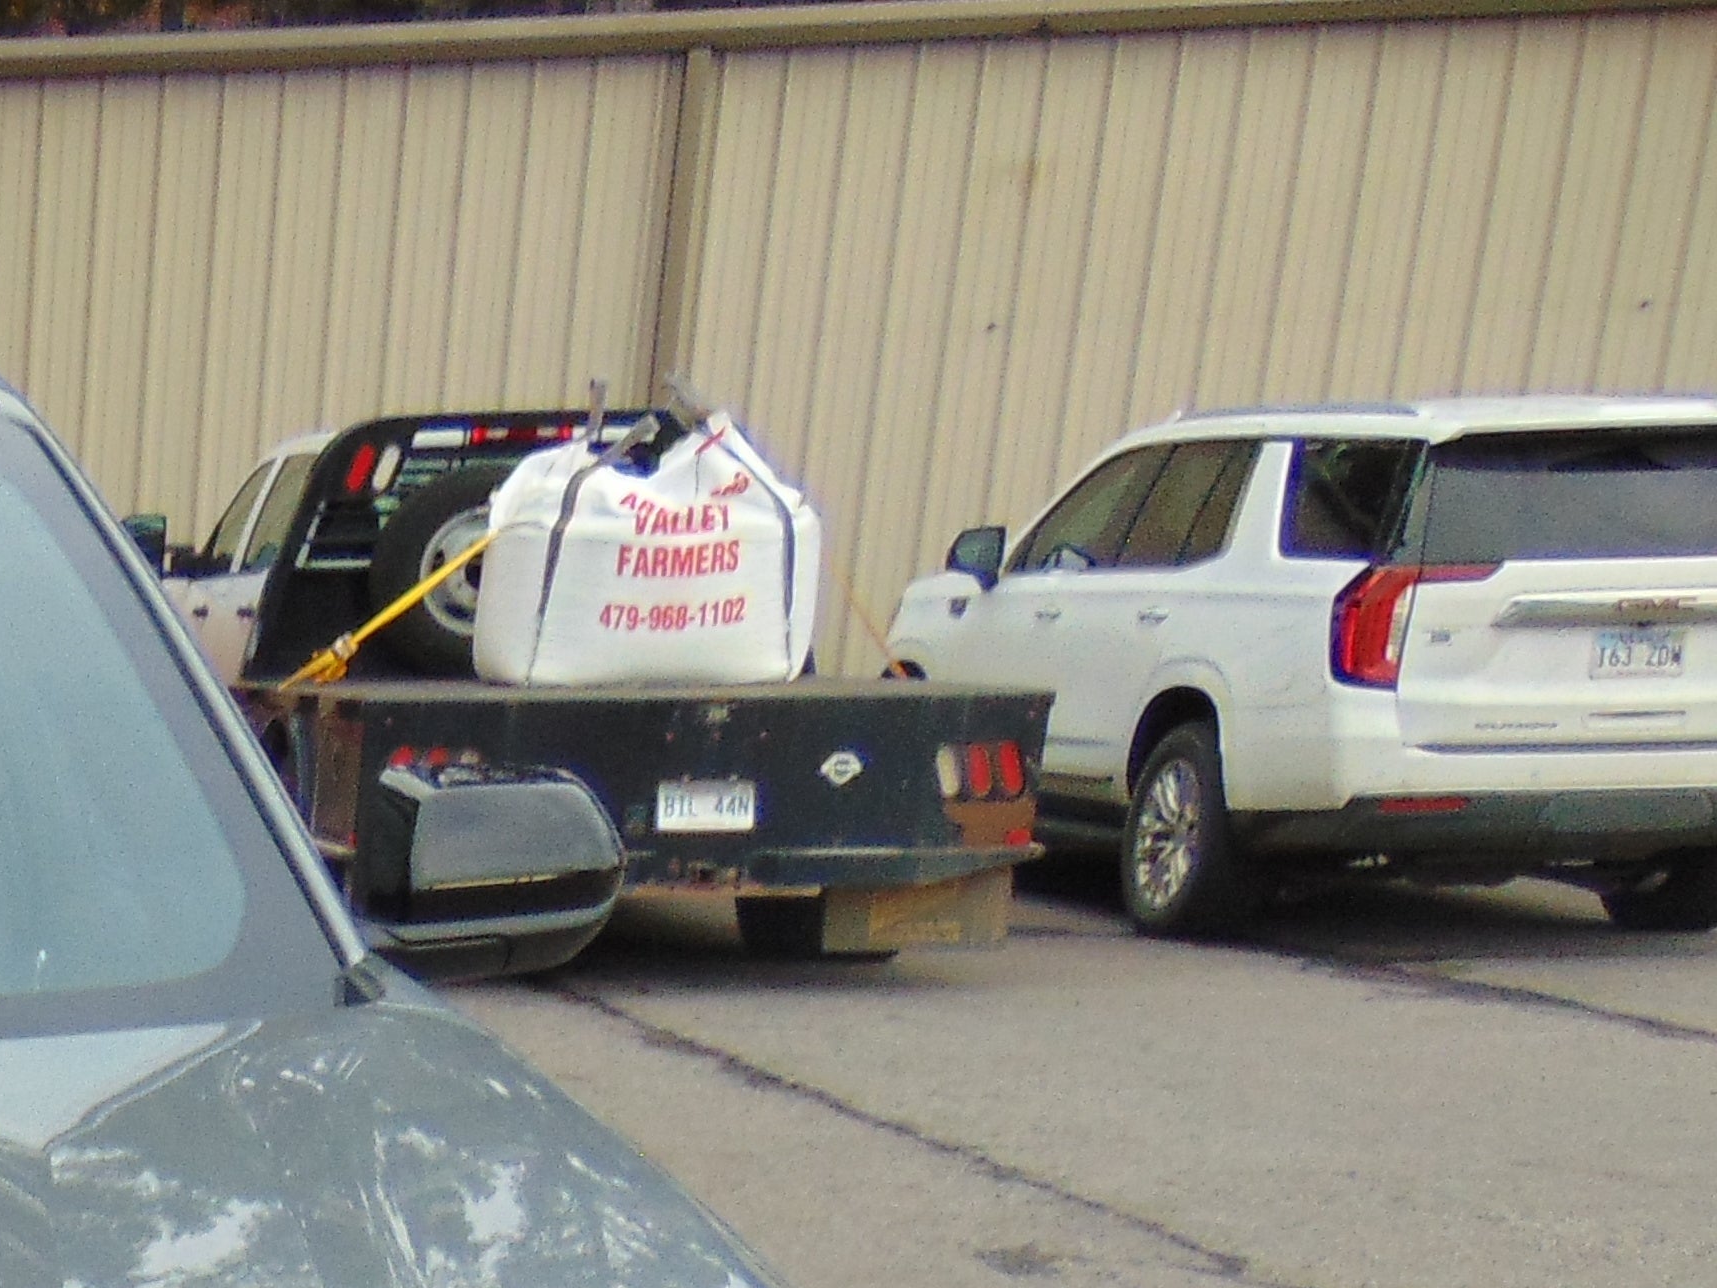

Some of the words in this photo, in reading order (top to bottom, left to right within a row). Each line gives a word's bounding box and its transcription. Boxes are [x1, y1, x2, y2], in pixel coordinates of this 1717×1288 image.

[635, 505, 729, 535] VALLEY
[617, 540, 740, 577] FARMERS
[599, 597, 746, 631] 479-968-1102
